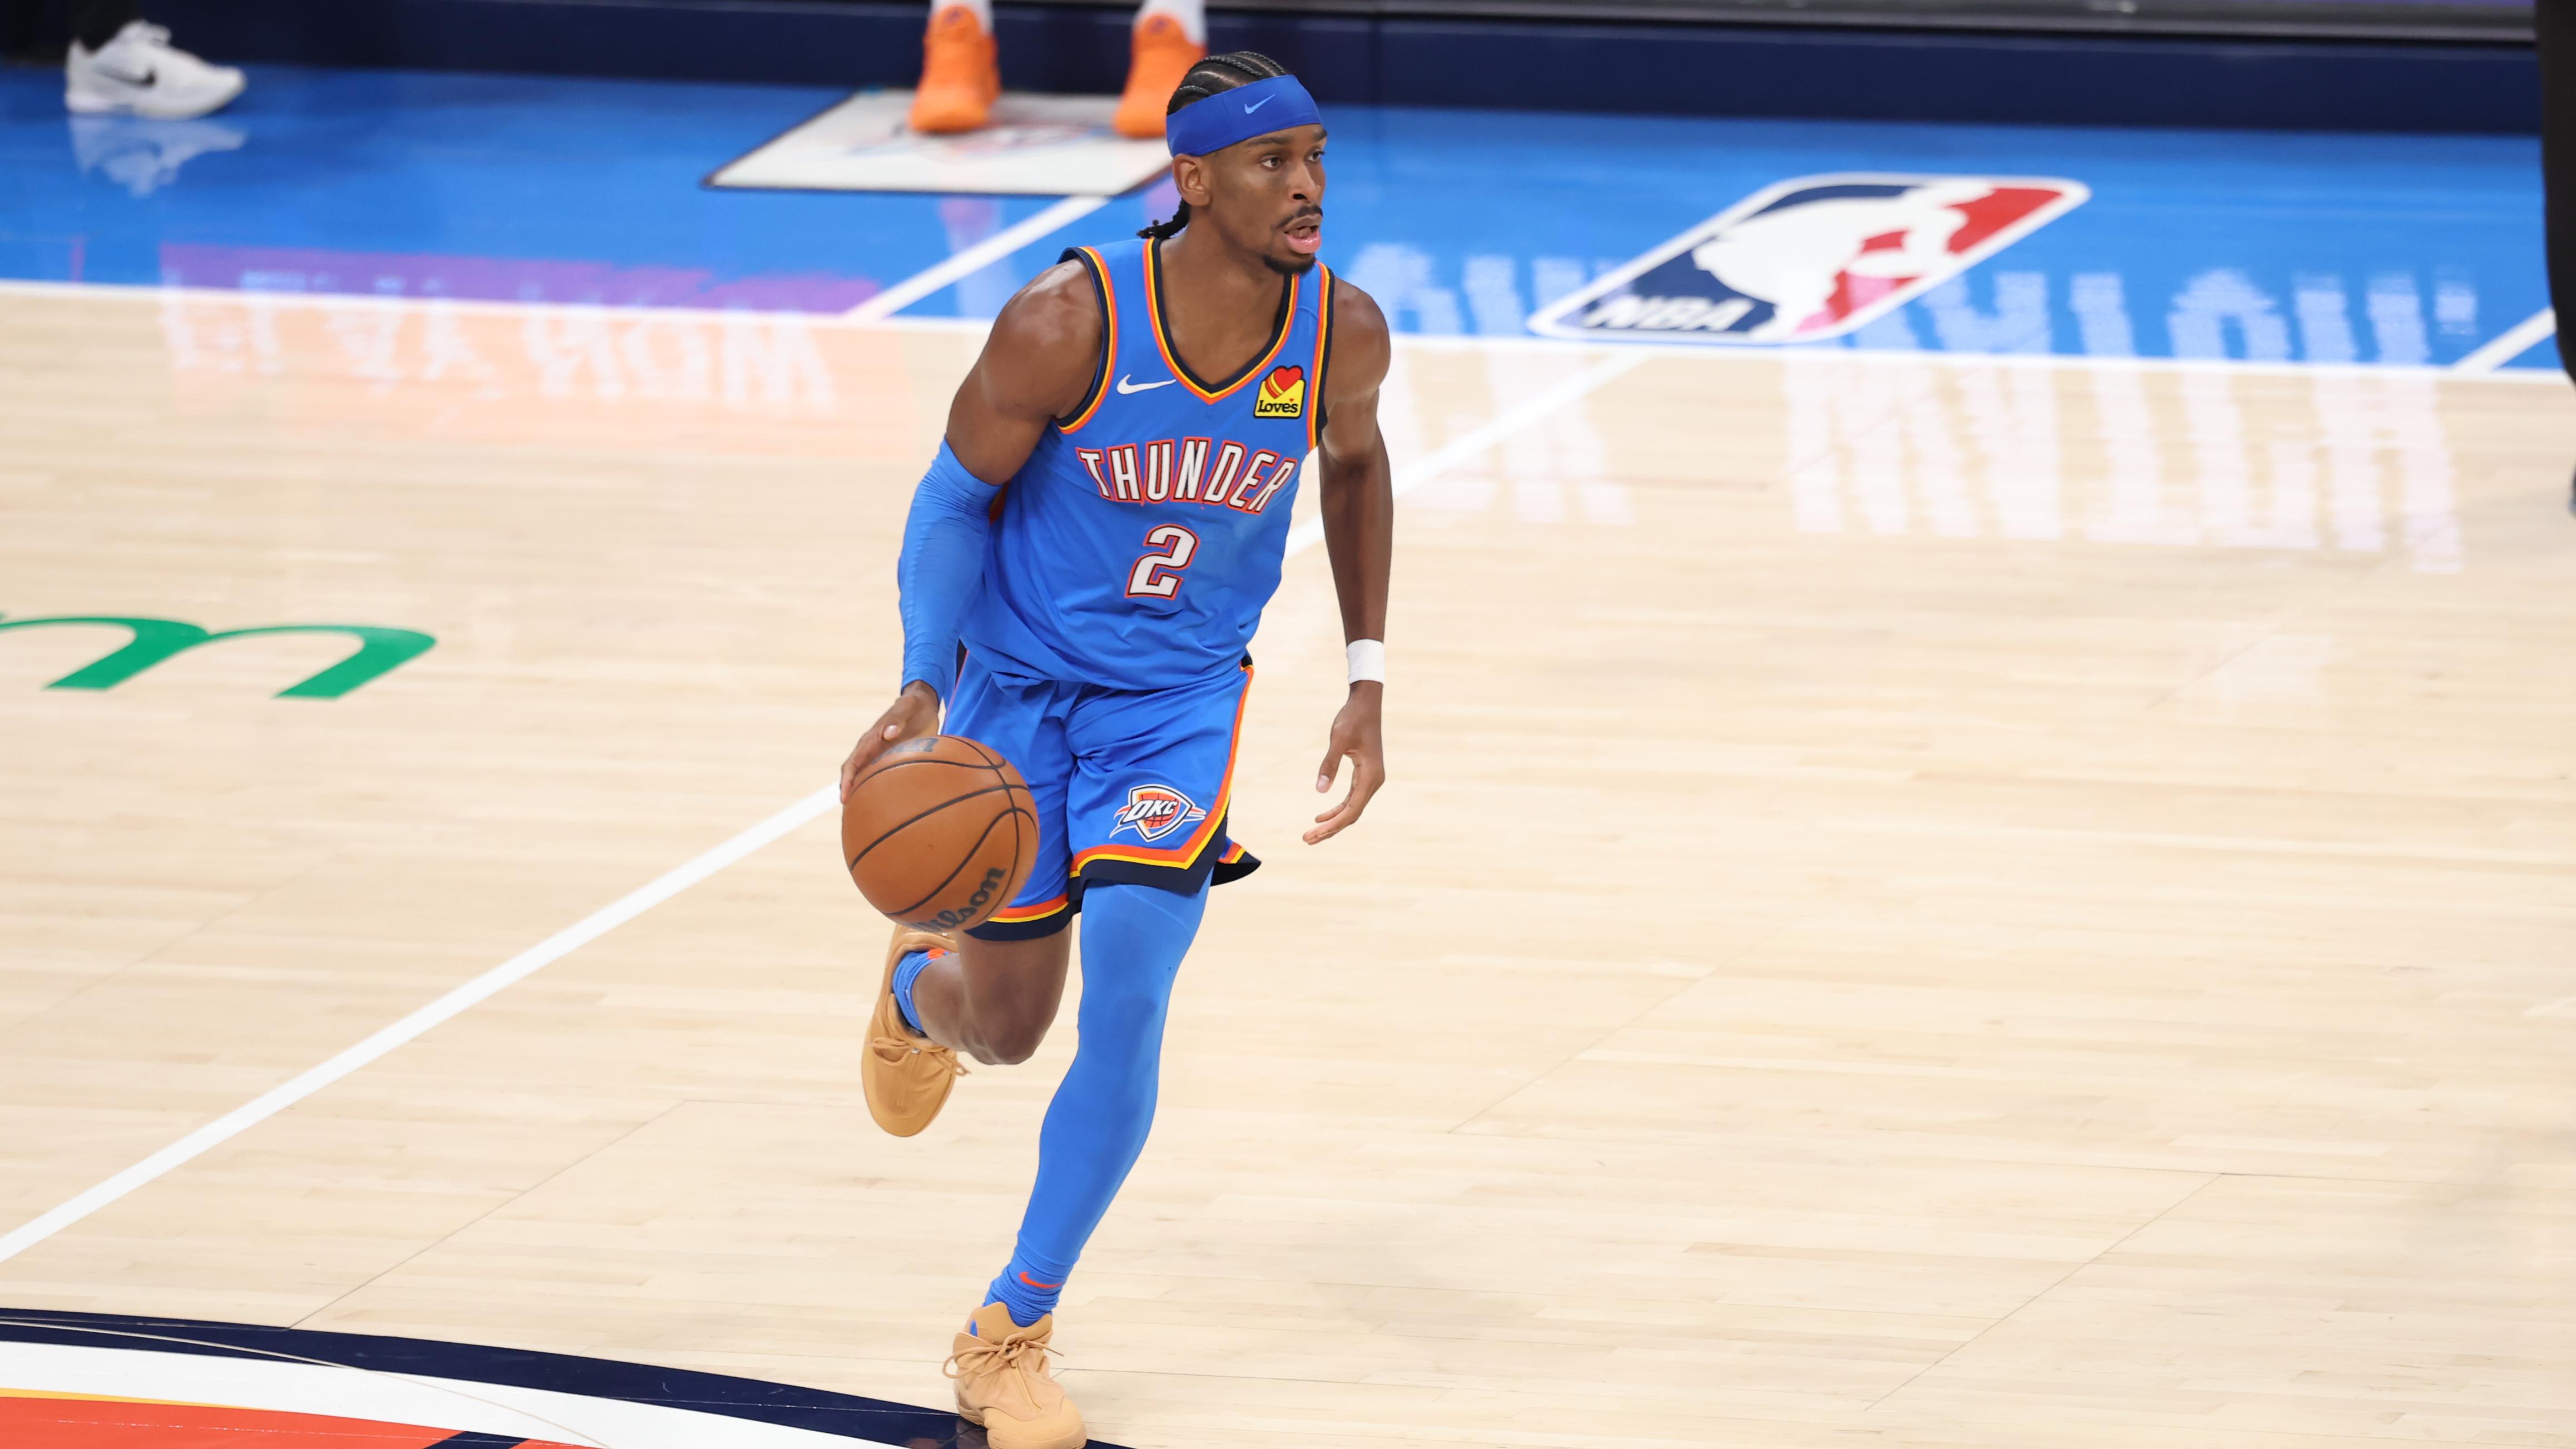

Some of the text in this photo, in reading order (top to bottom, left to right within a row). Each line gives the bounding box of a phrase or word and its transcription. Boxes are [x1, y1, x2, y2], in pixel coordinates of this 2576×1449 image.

[1582, 296, 1756, 330] NBA
[1075, 437, 1298, 514] THUNDER
[1124, 523, 1200, 600] 2
[1120, 799, 1179, 824] OKC
